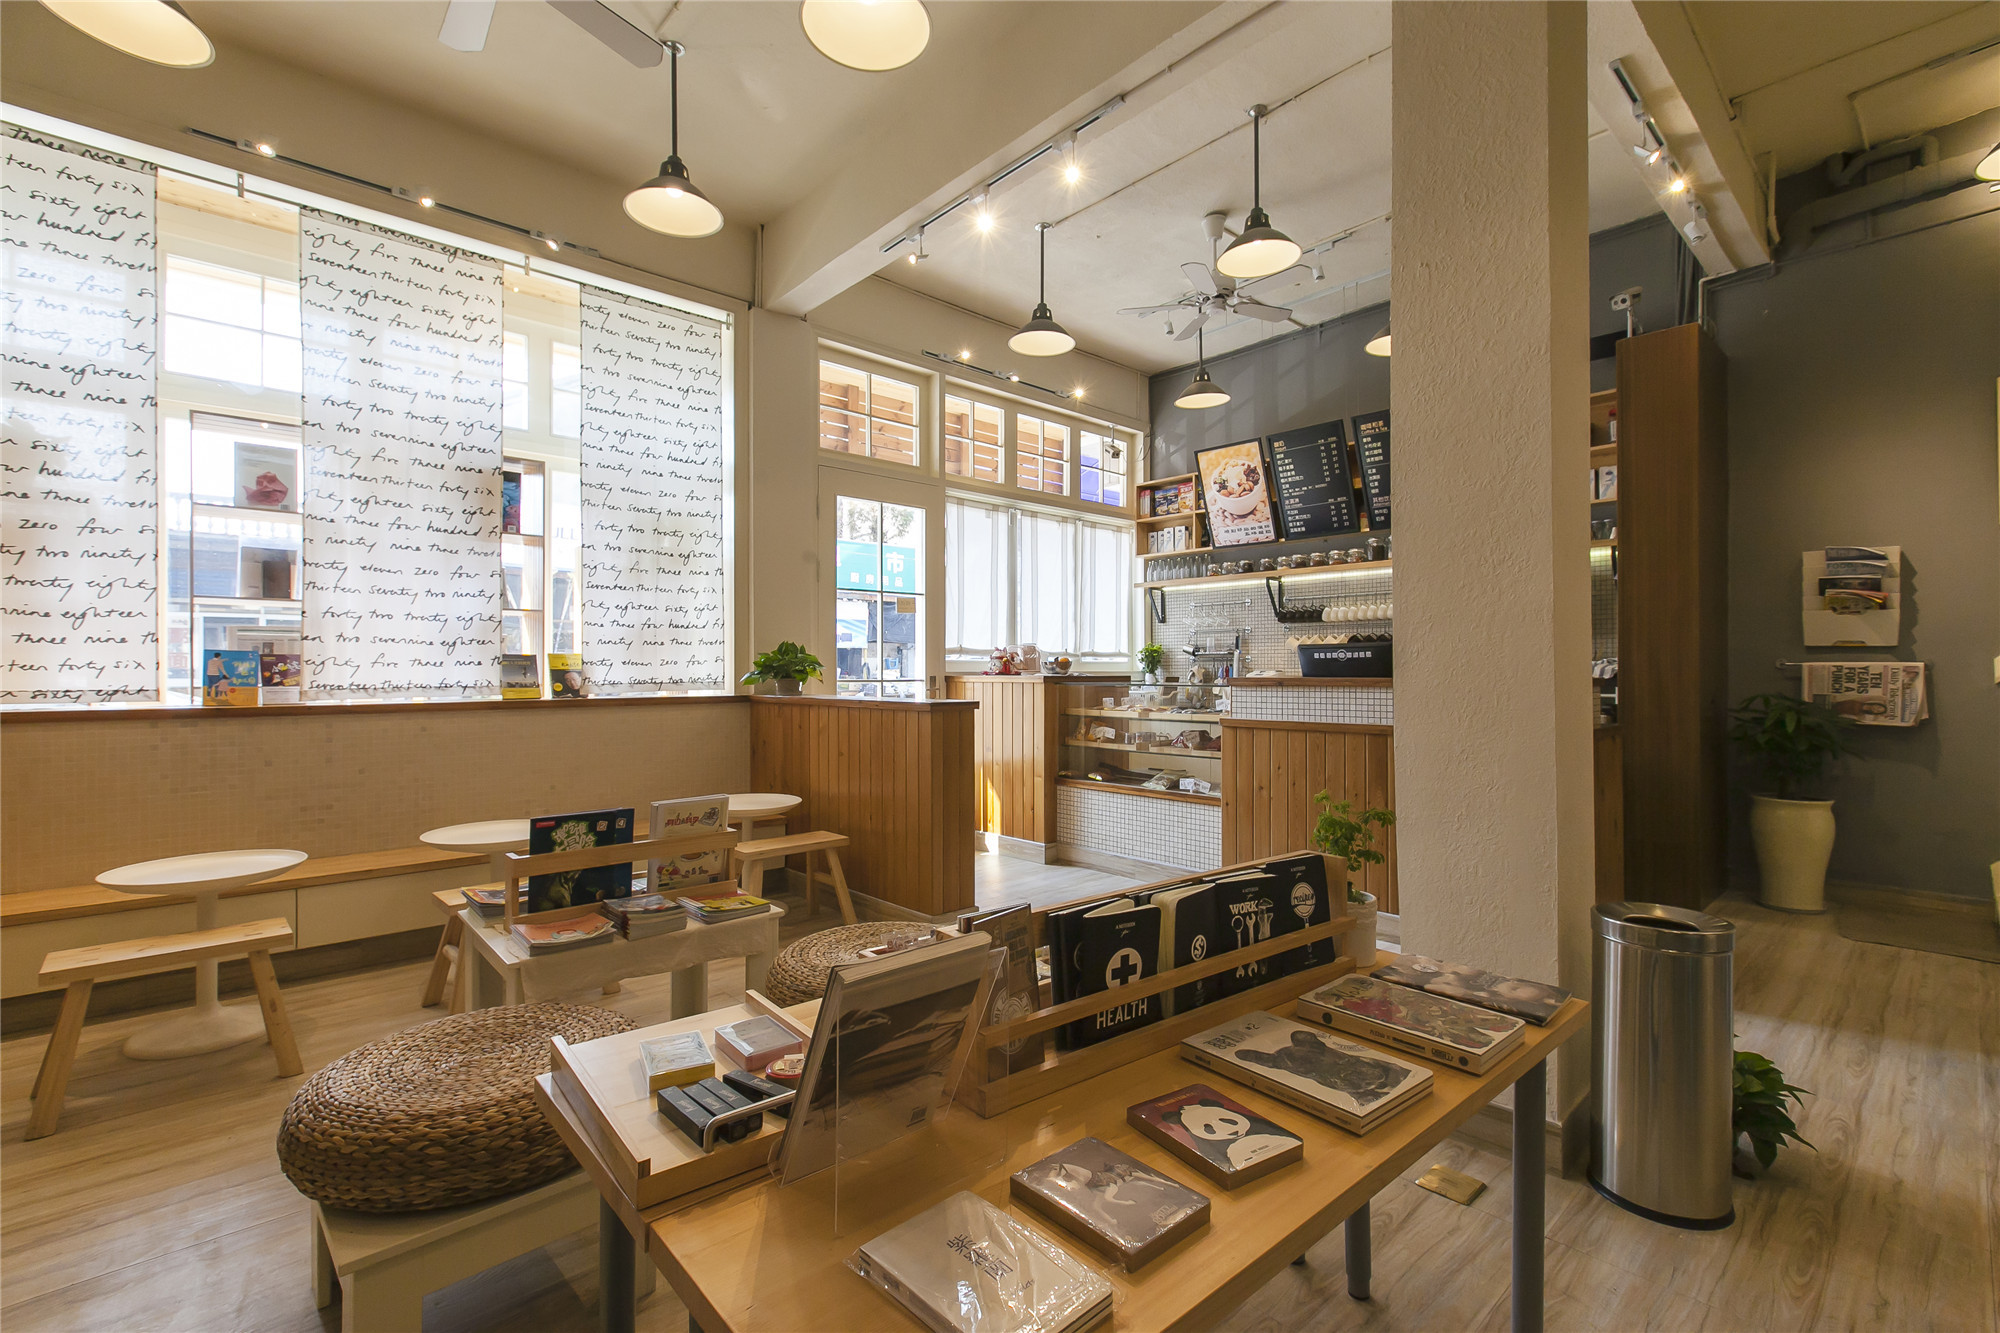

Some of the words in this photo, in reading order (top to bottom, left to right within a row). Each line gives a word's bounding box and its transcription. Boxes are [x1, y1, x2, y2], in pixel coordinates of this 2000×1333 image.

[886, 552, 905, 574] 市
[1832, 665, 1843, 694] PUNCH
[1844, 667, 1856, 683] FOR
[1857, 666, 1870, 695] YEARS
[1870, 672, 1882, 689] TEN
[1888, 667, 1900, 686] Daily
[1844, 685, 1855, 693] A
[1229, 900, 1258, 914] WORK
[1097, 998, 1147, 1029] HEALTH
